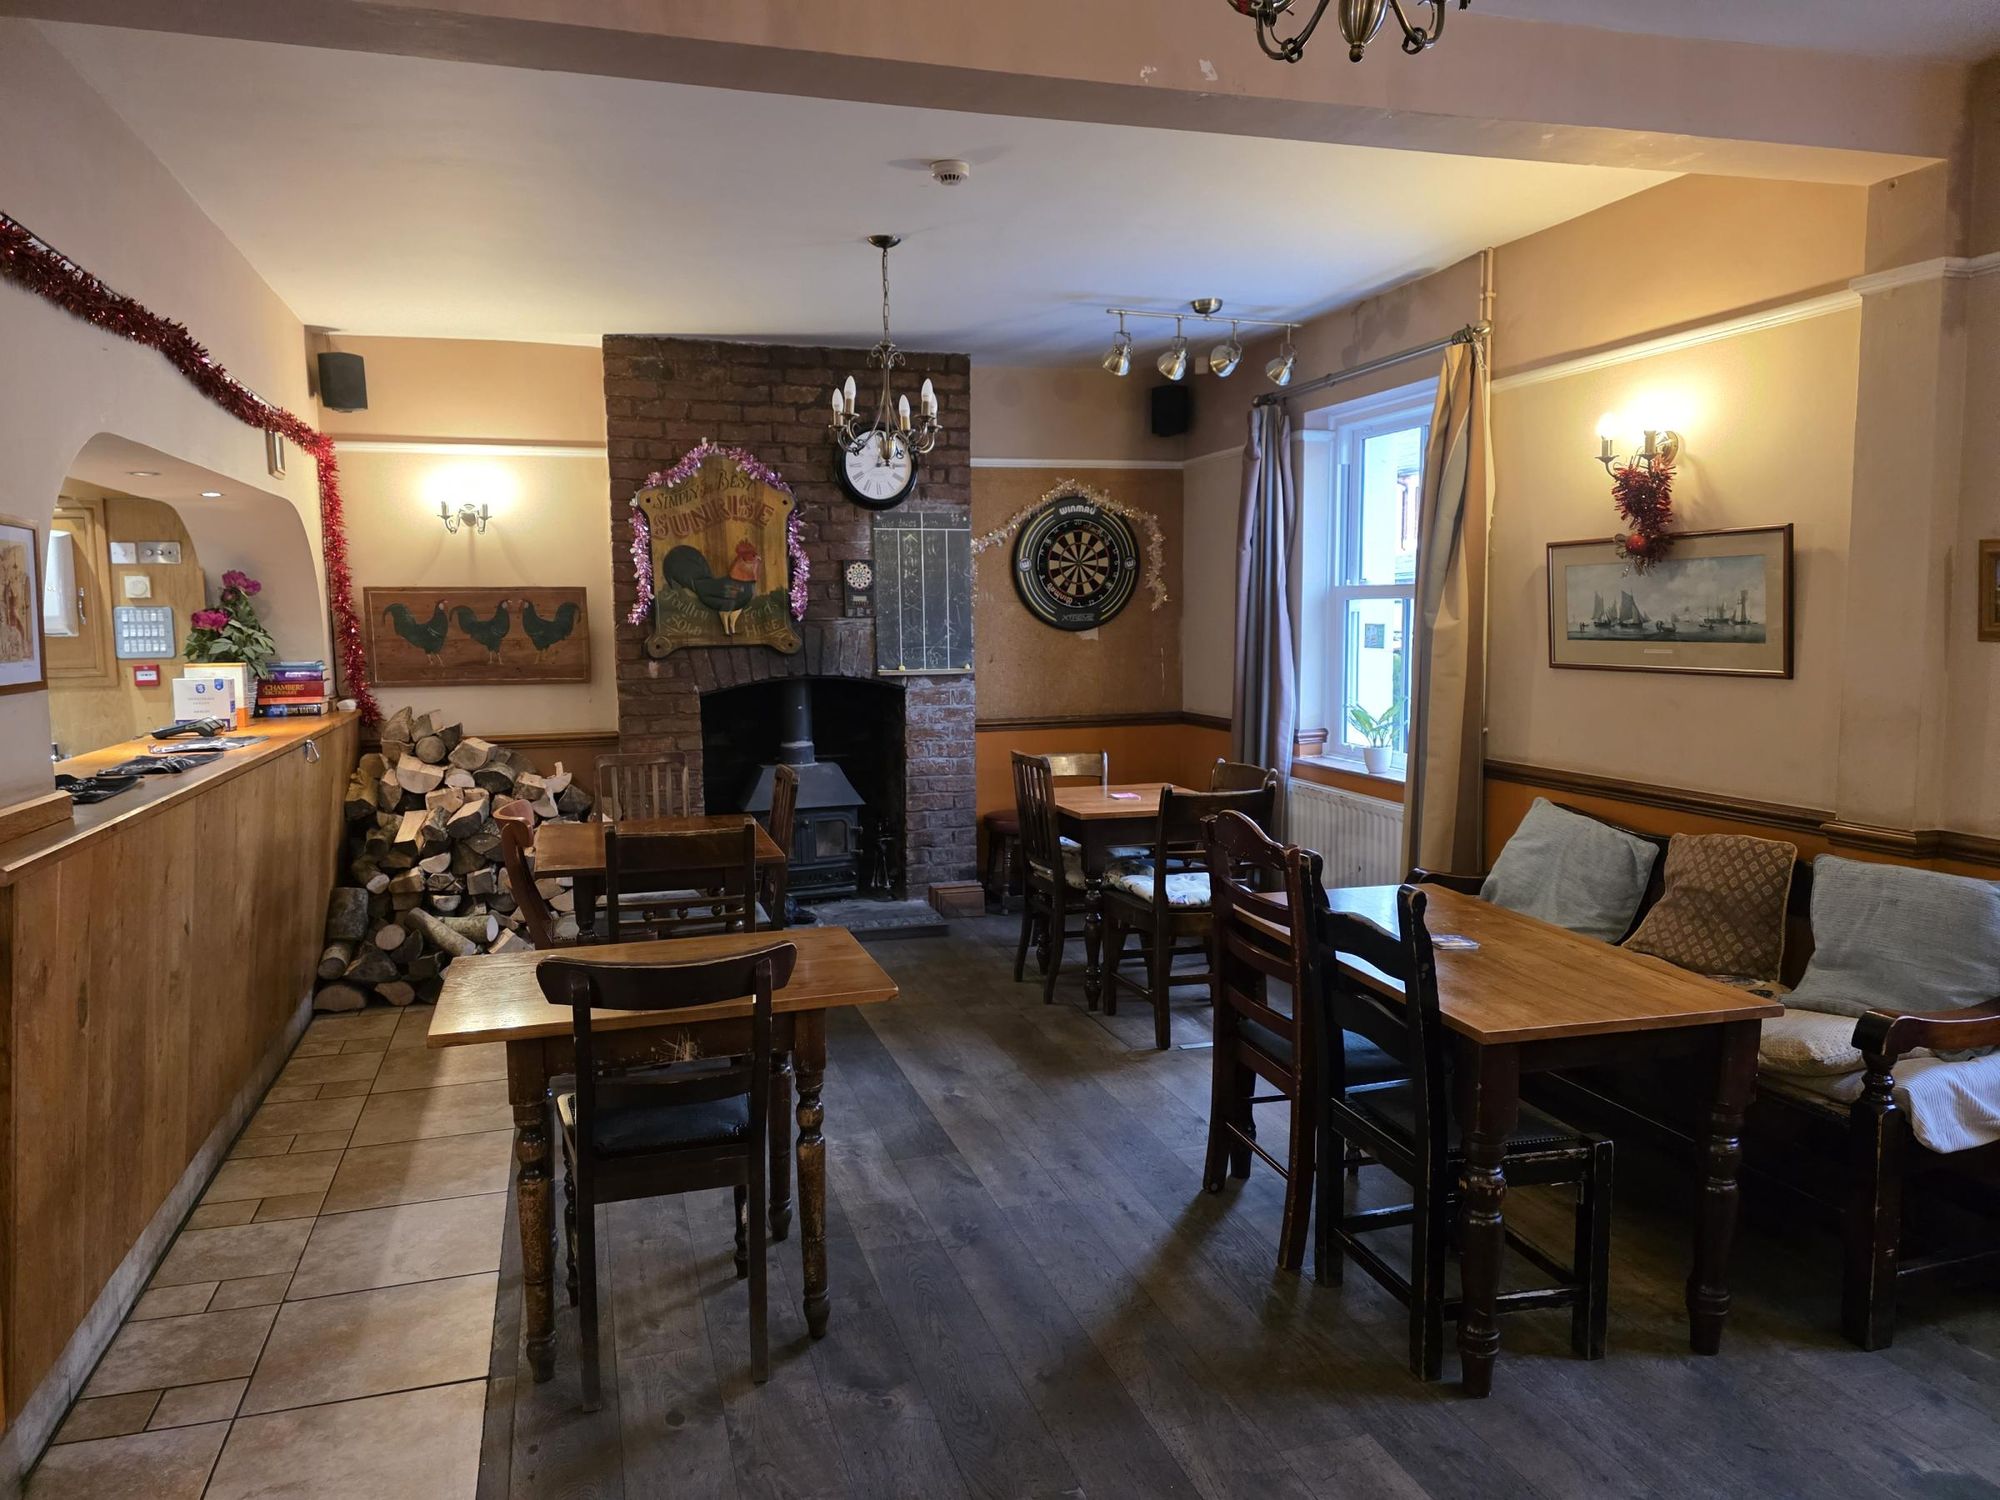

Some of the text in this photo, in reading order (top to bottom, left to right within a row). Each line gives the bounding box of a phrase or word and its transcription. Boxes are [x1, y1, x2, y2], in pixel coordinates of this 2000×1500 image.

[653, 484, 700, 510] SIMPLY
[717, 469, 755, 491] BEST
[652, 495, 775, 540] SUNRISE
